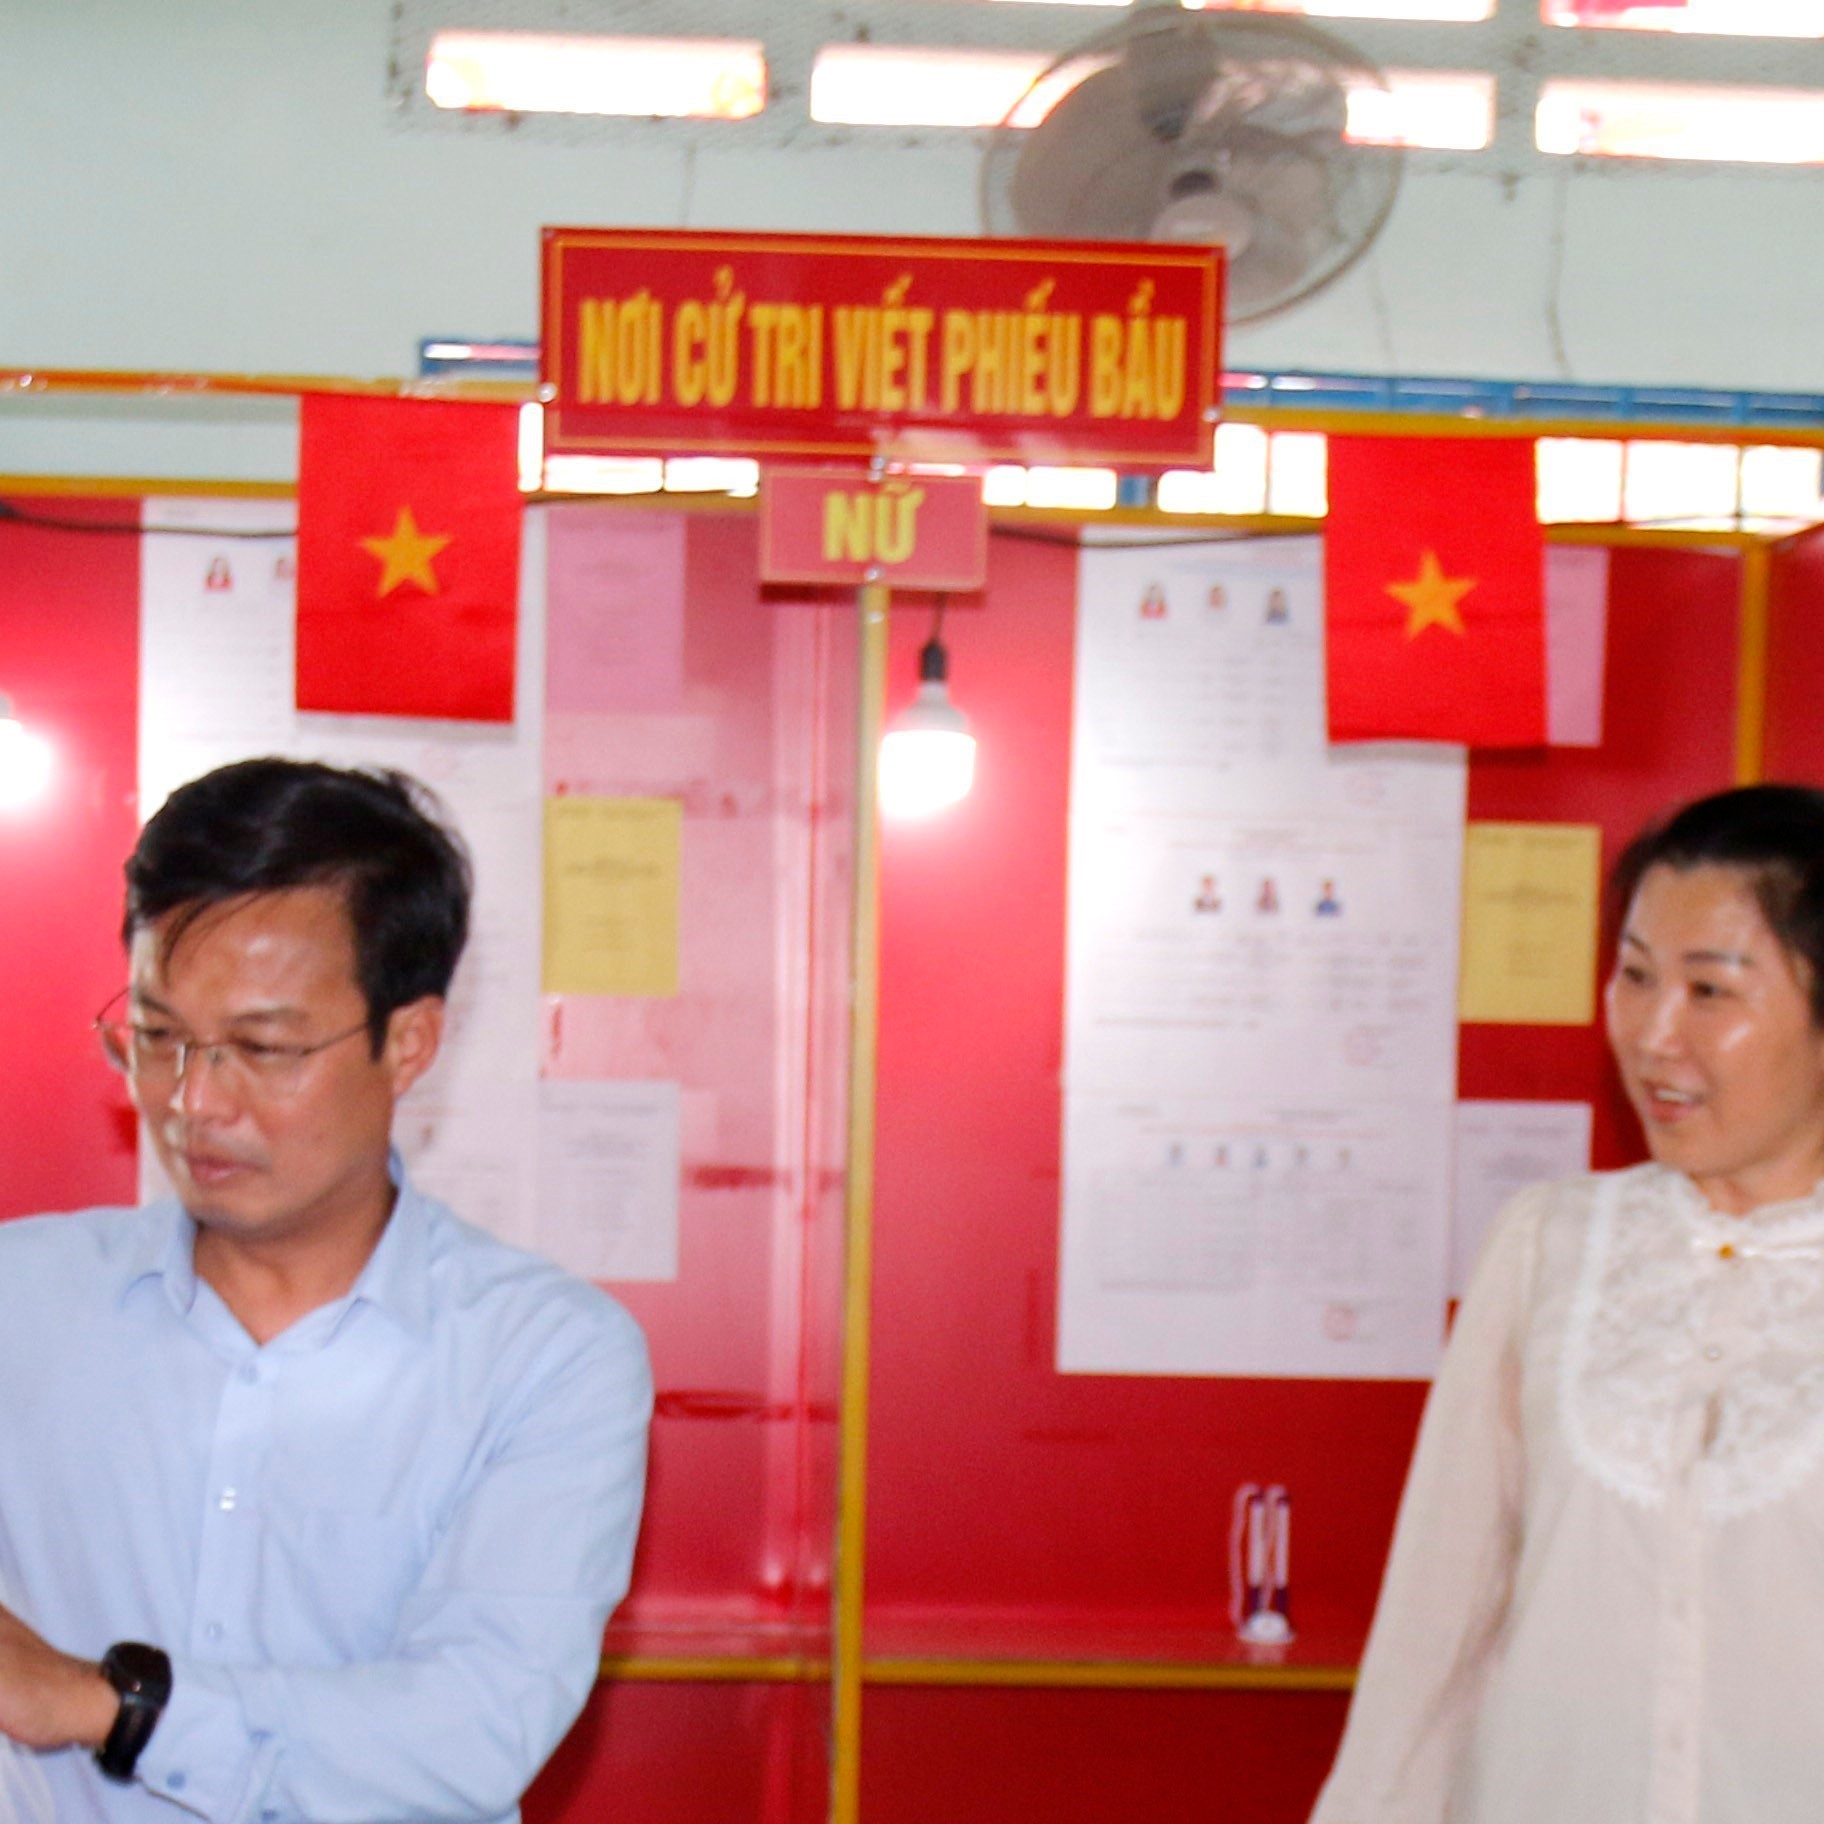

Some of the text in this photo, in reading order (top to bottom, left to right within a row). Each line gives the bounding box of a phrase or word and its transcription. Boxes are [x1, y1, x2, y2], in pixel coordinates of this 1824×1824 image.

[579, 288, 663, 407] NƠI
[675, 264, 747, 409] CỬ
[750, 303, 825, 409] TRI
[833, 272, 934, 411] VIẾT
[941, 276, 1082, 418] PHIẾU
[822, 481, 925, 565] NỮ
